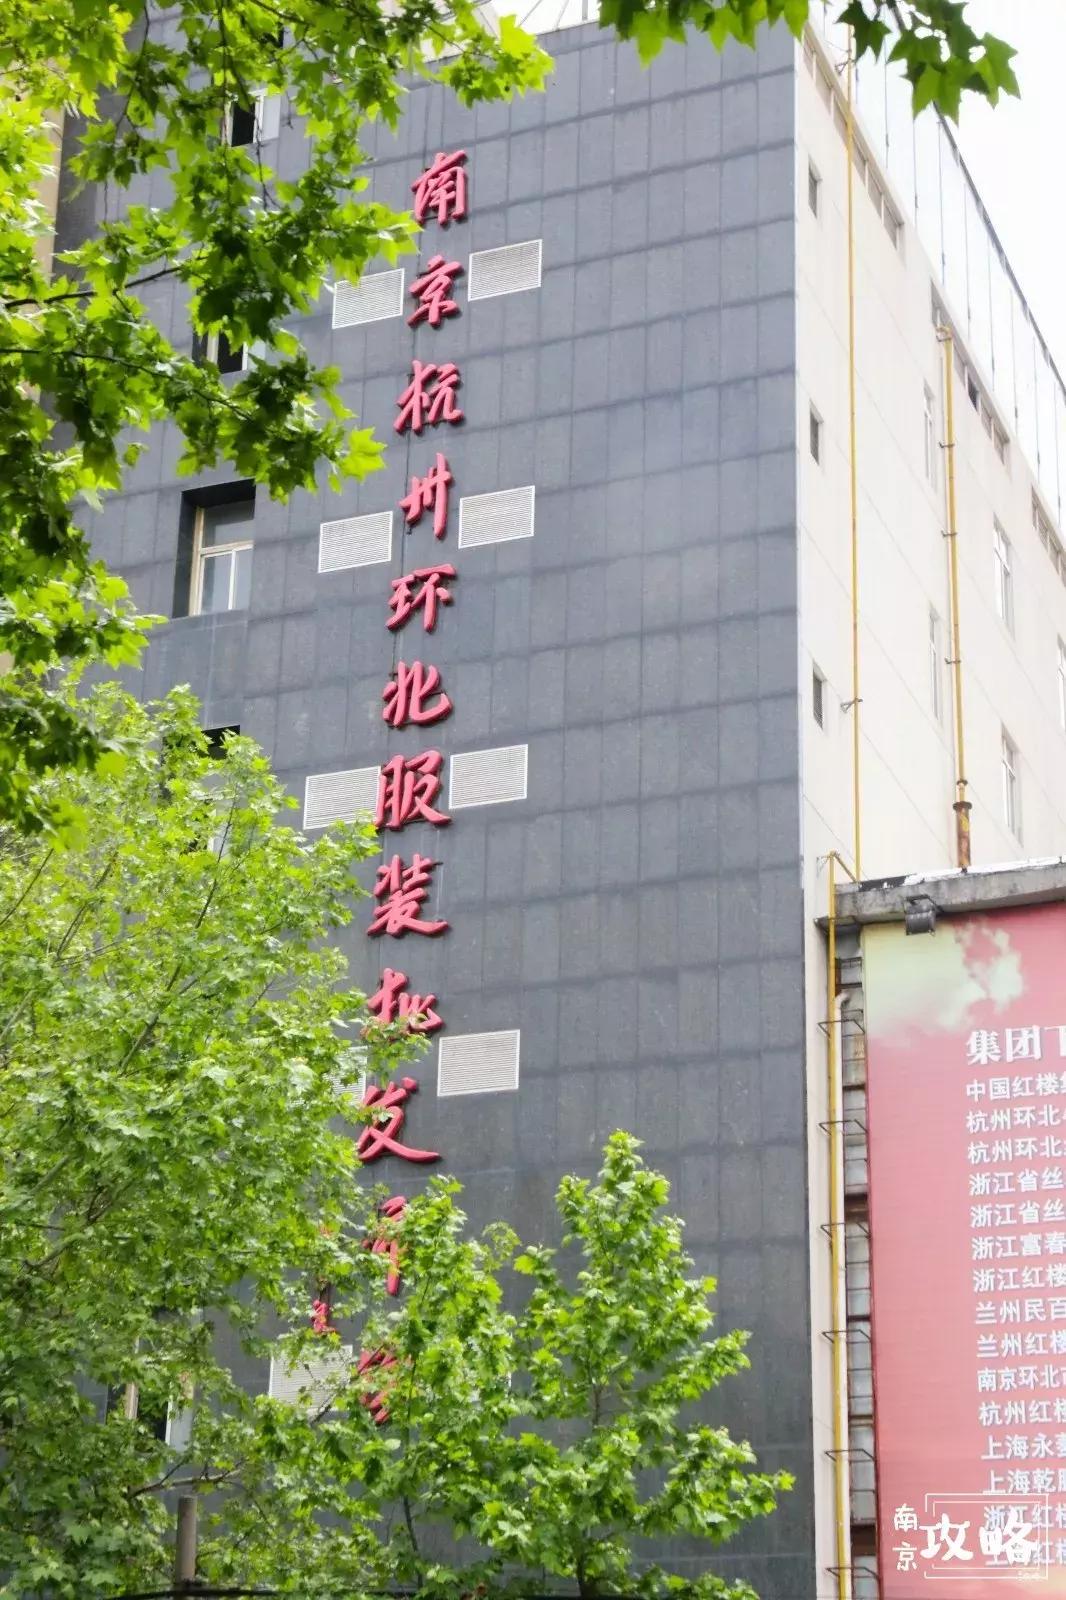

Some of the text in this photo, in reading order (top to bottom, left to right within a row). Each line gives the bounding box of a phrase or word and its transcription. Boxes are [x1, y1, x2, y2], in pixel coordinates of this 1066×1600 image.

[356, 149, 468, 1425] 南京杭州环北服装批发
[966, 1071, 1066, 1102] 中国红楼
[966, 1104, 1066, 1133] 杭州环北
[967, 1135, 1066, 1164] 杭州环北
[969, 1166, 1064, 1196] 浙江省丝
[970, 1198, 1066, 1228] 浙江省丝
[971, 1231, 1066, 1260] 浙江富春
[972, 1262, 1066, 1292] 浙江红楼
[975, 1297, 1066, 1325] 兰州民百
[977, 1364, 1066, 1392] 南京环北
